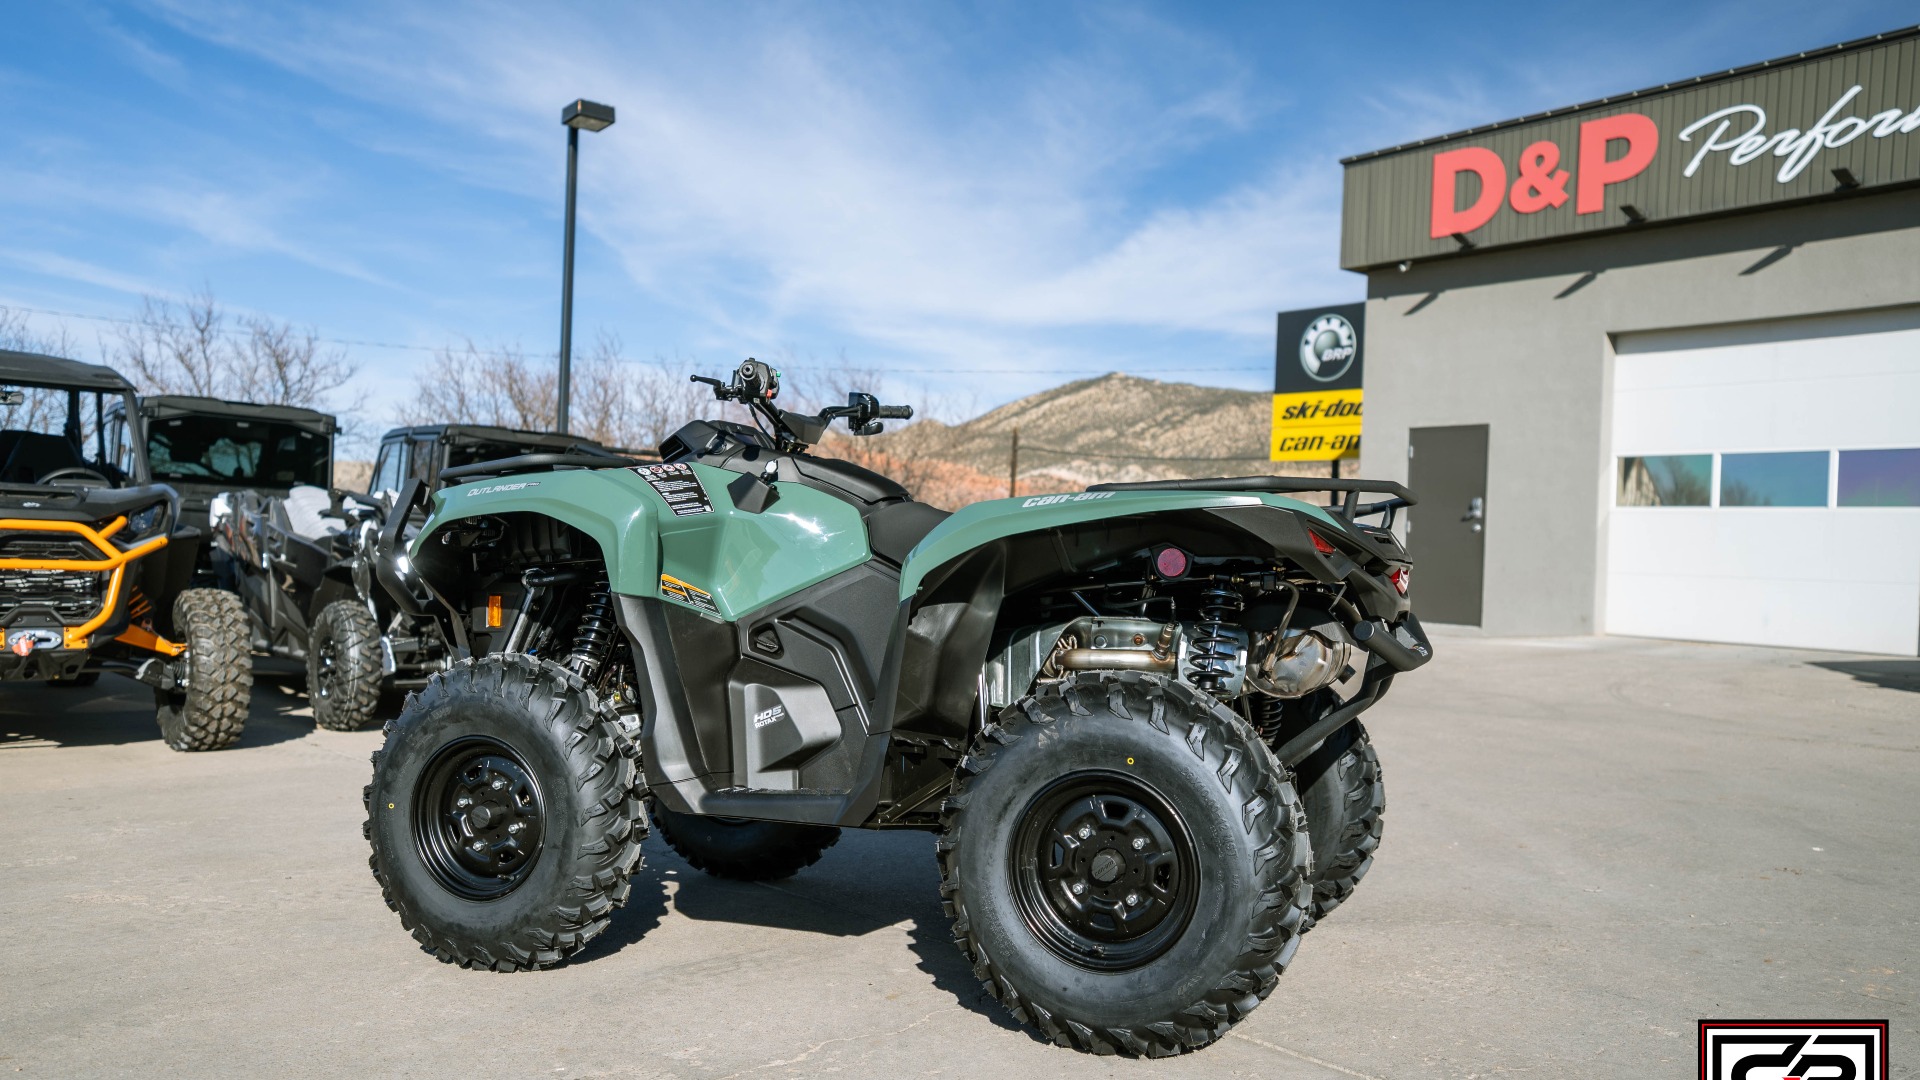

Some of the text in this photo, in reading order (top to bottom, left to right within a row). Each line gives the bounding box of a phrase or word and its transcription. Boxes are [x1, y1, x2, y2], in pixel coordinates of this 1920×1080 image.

[1431, 85, 1920, 239] D&P Perfor
[1321, 346, 1354, 362] BRP
[467, 482, 527, 496] OUTLANDER
[1022, 491, 1117, 508] can-am
[754, 716, 777, 728] ROTAX
